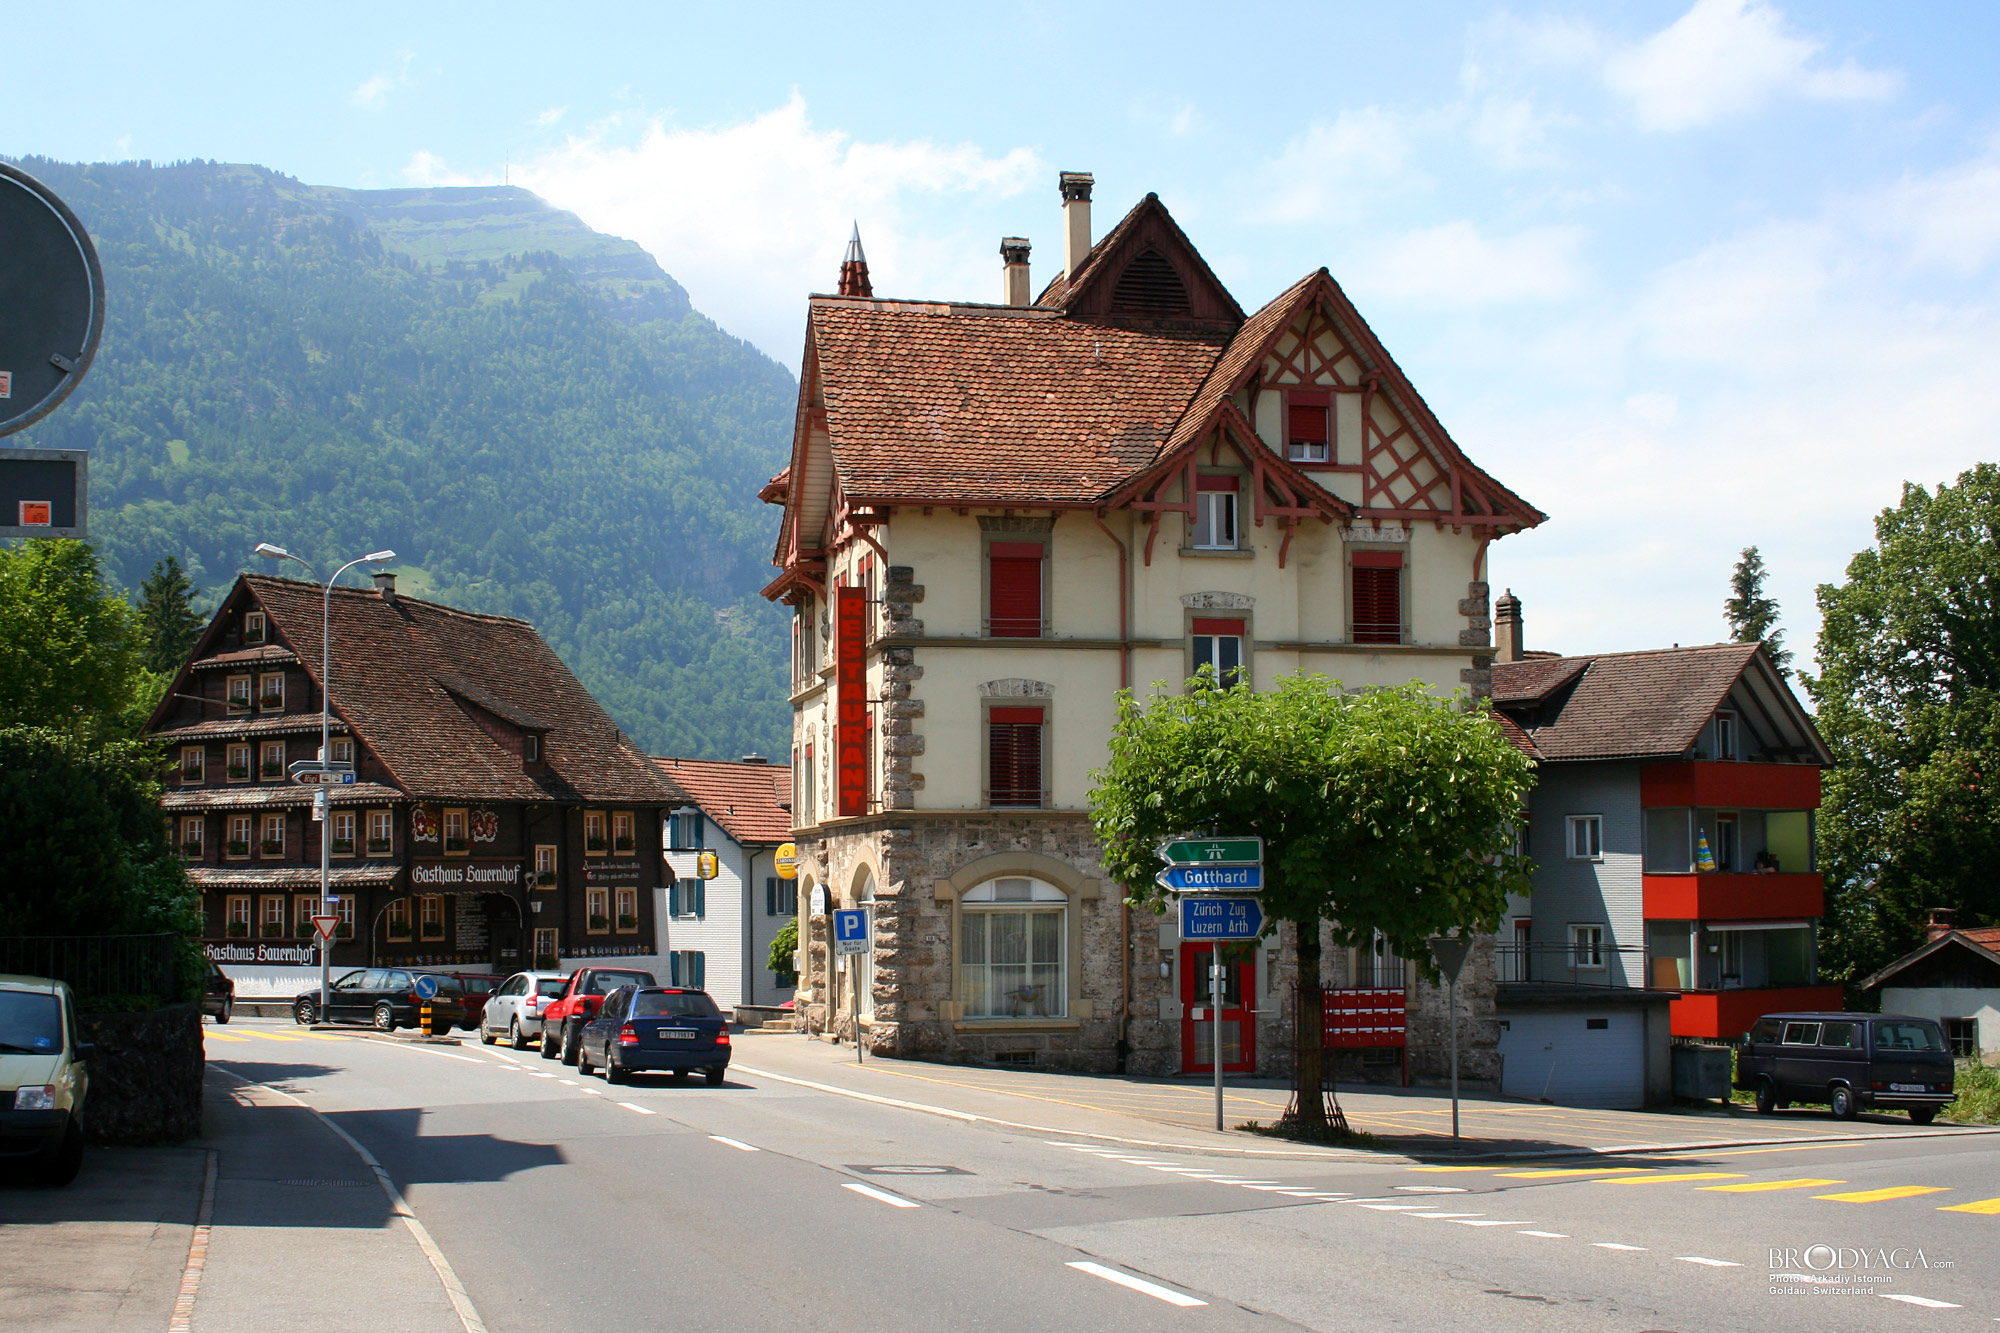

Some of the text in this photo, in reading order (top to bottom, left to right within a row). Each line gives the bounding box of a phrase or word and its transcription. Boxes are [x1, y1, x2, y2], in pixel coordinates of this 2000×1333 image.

[840, 597, 865, 808] RESTAURANT
[304, 774, 318, 784] Rigi
[345, 774, 351, 783] P
[412, 864, 521, 885] Gasthaus Bauernhof
[1184, 869, 1248, 884] Gotthard
[1193, 902, 1246, 919] Zürich Zug
[843, 914, 859, 938] P
[1191, 920, 1249, 934] Luzern Arth
[202, 943, 317, 966] Gasthaus Bauernhof
